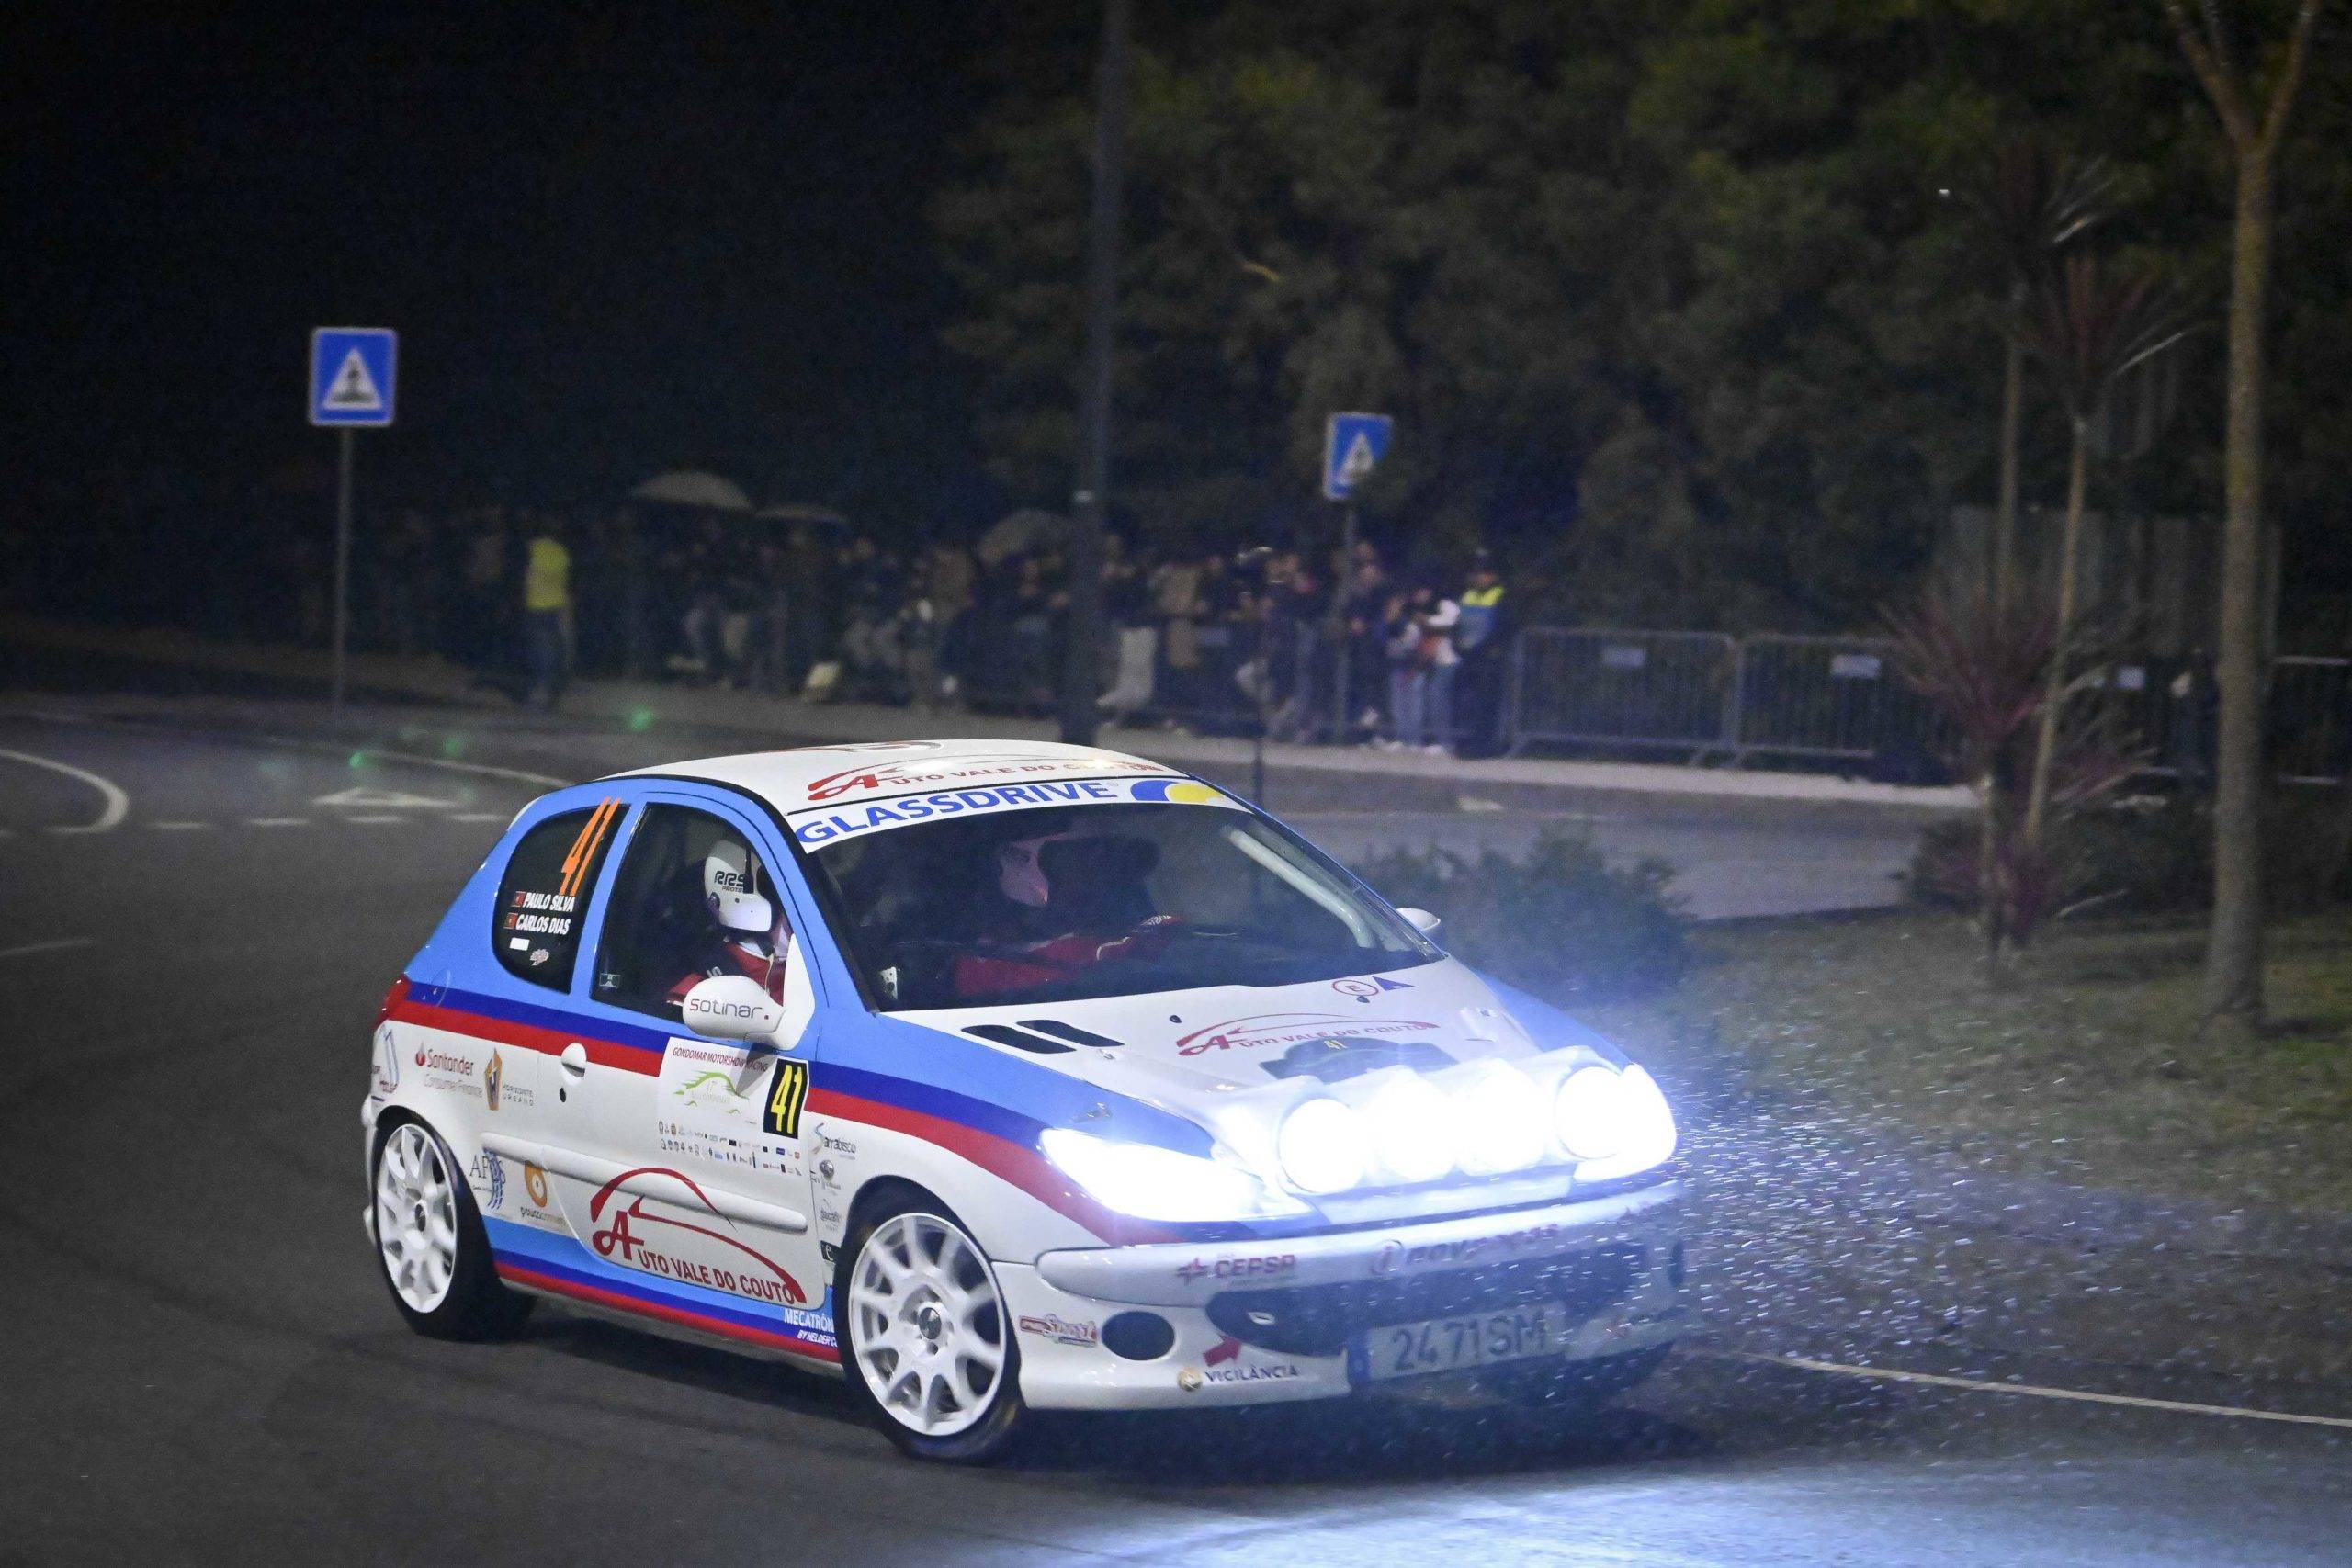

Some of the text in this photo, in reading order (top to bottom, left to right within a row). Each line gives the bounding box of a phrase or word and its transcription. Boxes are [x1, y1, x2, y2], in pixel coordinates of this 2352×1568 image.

[950, 766, 1014, 777] VALE
[795, 782, 1118, 844] GLASSDRIVE
[522, 892, 576, 912] PAULO SILVA
[515, 914, 571, 936] CARLOS DIAS
[689, 998, 762, 1019] sotinar
[1284, 1032, 1327, 1042] VALE
[427, 1048, 474, 1076] Santander
[673, 1047, 769, 1073] GONDOMAR MOTORSHOW RACING
[770, 1064, 802, 1134] 41
[671, 1257, 708, 1285] VALE
[713, 1268, 735, 1291] DO
[739, 1274, 795, 1304] COUTO
[1204, 1364, 1298, 1382] VIGILÂNCIA
